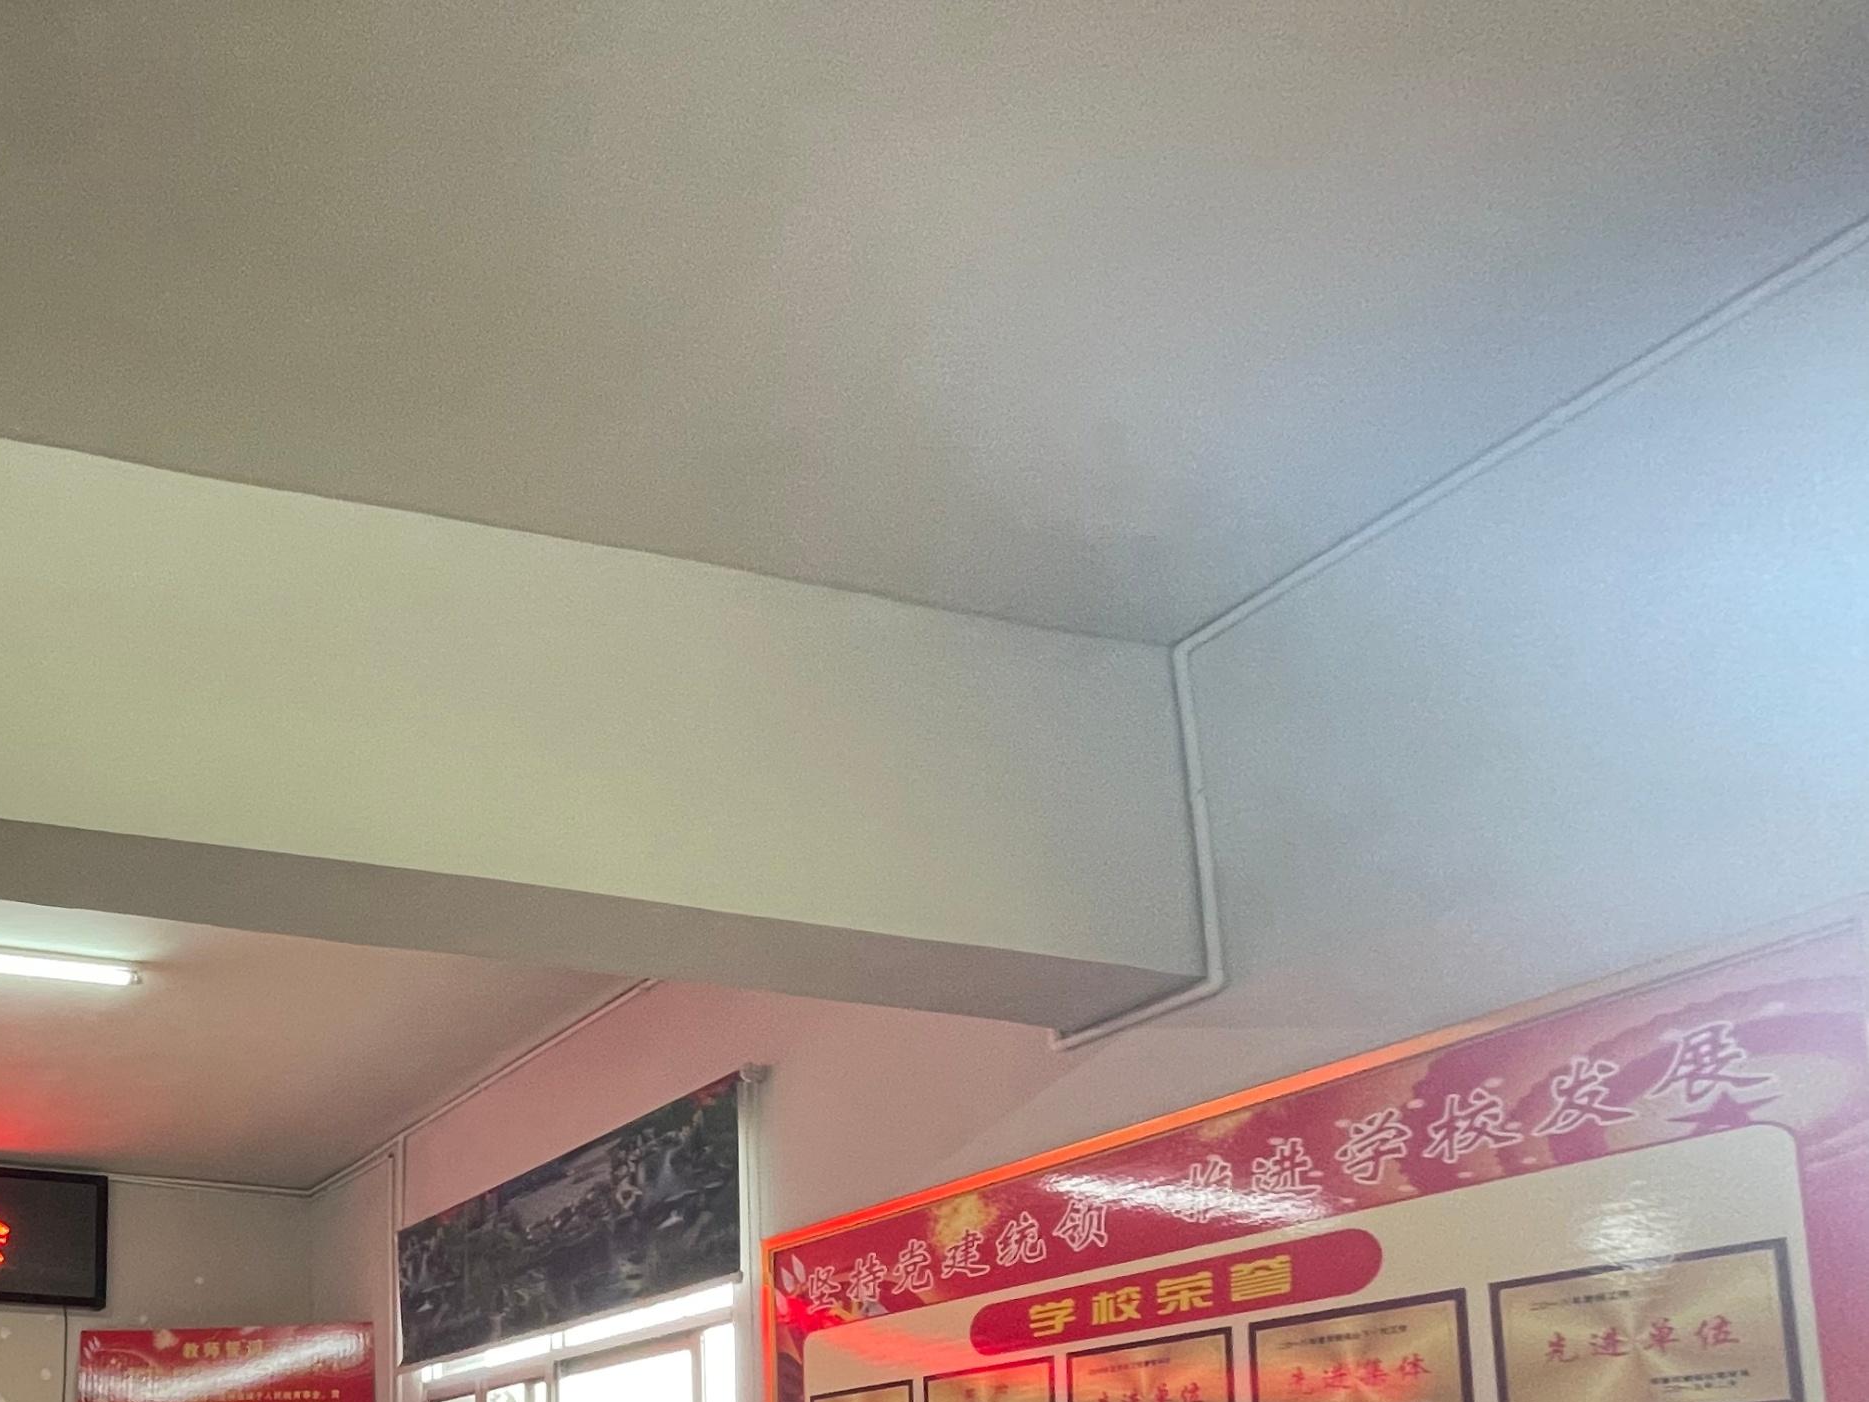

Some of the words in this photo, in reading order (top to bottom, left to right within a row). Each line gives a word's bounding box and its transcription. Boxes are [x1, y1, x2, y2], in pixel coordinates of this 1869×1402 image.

[807, 1200, 1108, 1314] 坚持党建统领
[1028, 1255, 1292, 1338] 学校荣誉
[1545, 1314, 1741, 1363] 先进单位
[1287, 1352, 1432, 1396] 先进集体
